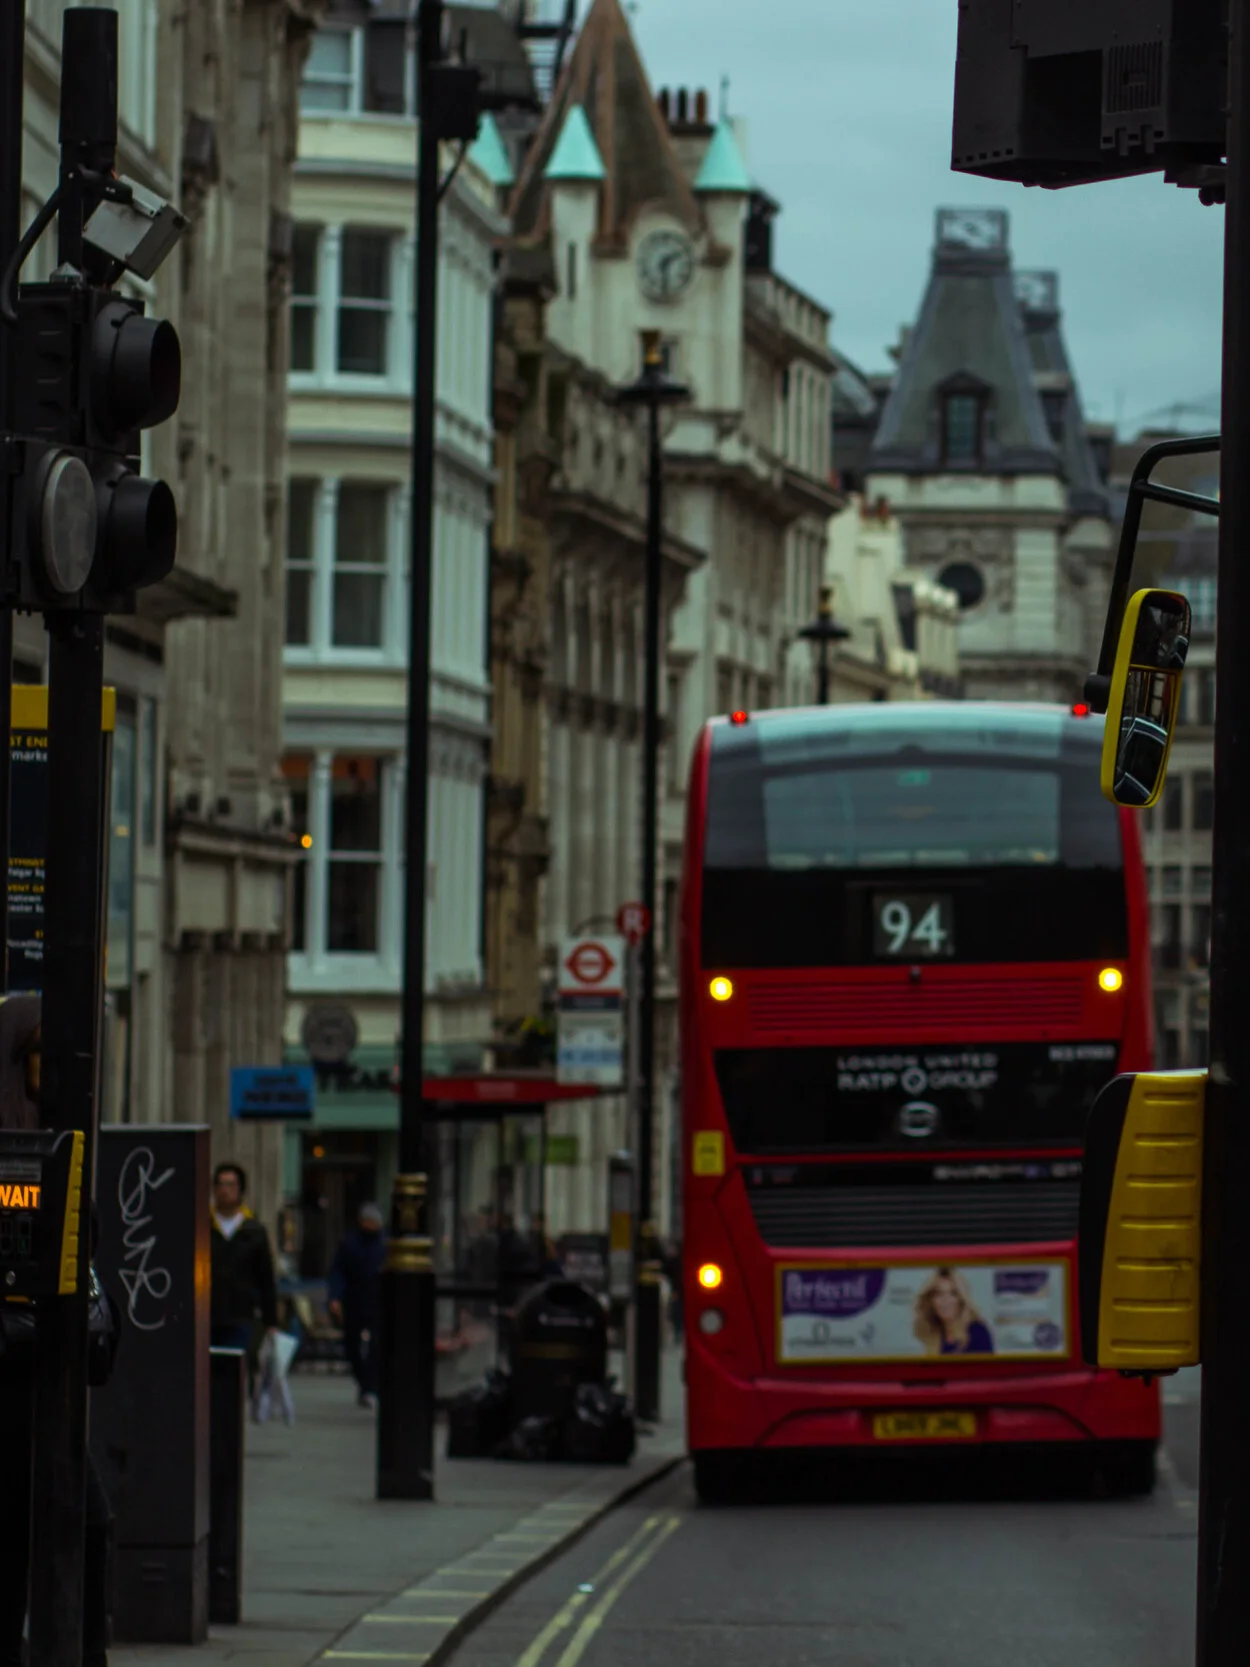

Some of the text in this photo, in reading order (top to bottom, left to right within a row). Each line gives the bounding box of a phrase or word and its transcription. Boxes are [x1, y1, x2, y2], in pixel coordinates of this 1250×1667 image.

[881, 899, 948, 956] 94
[836, 1052, 998, 1070] LONDON UNITED
[836, 1073, 898, 1091] RATP
[0, 1184, 41, 1208] WAIT
